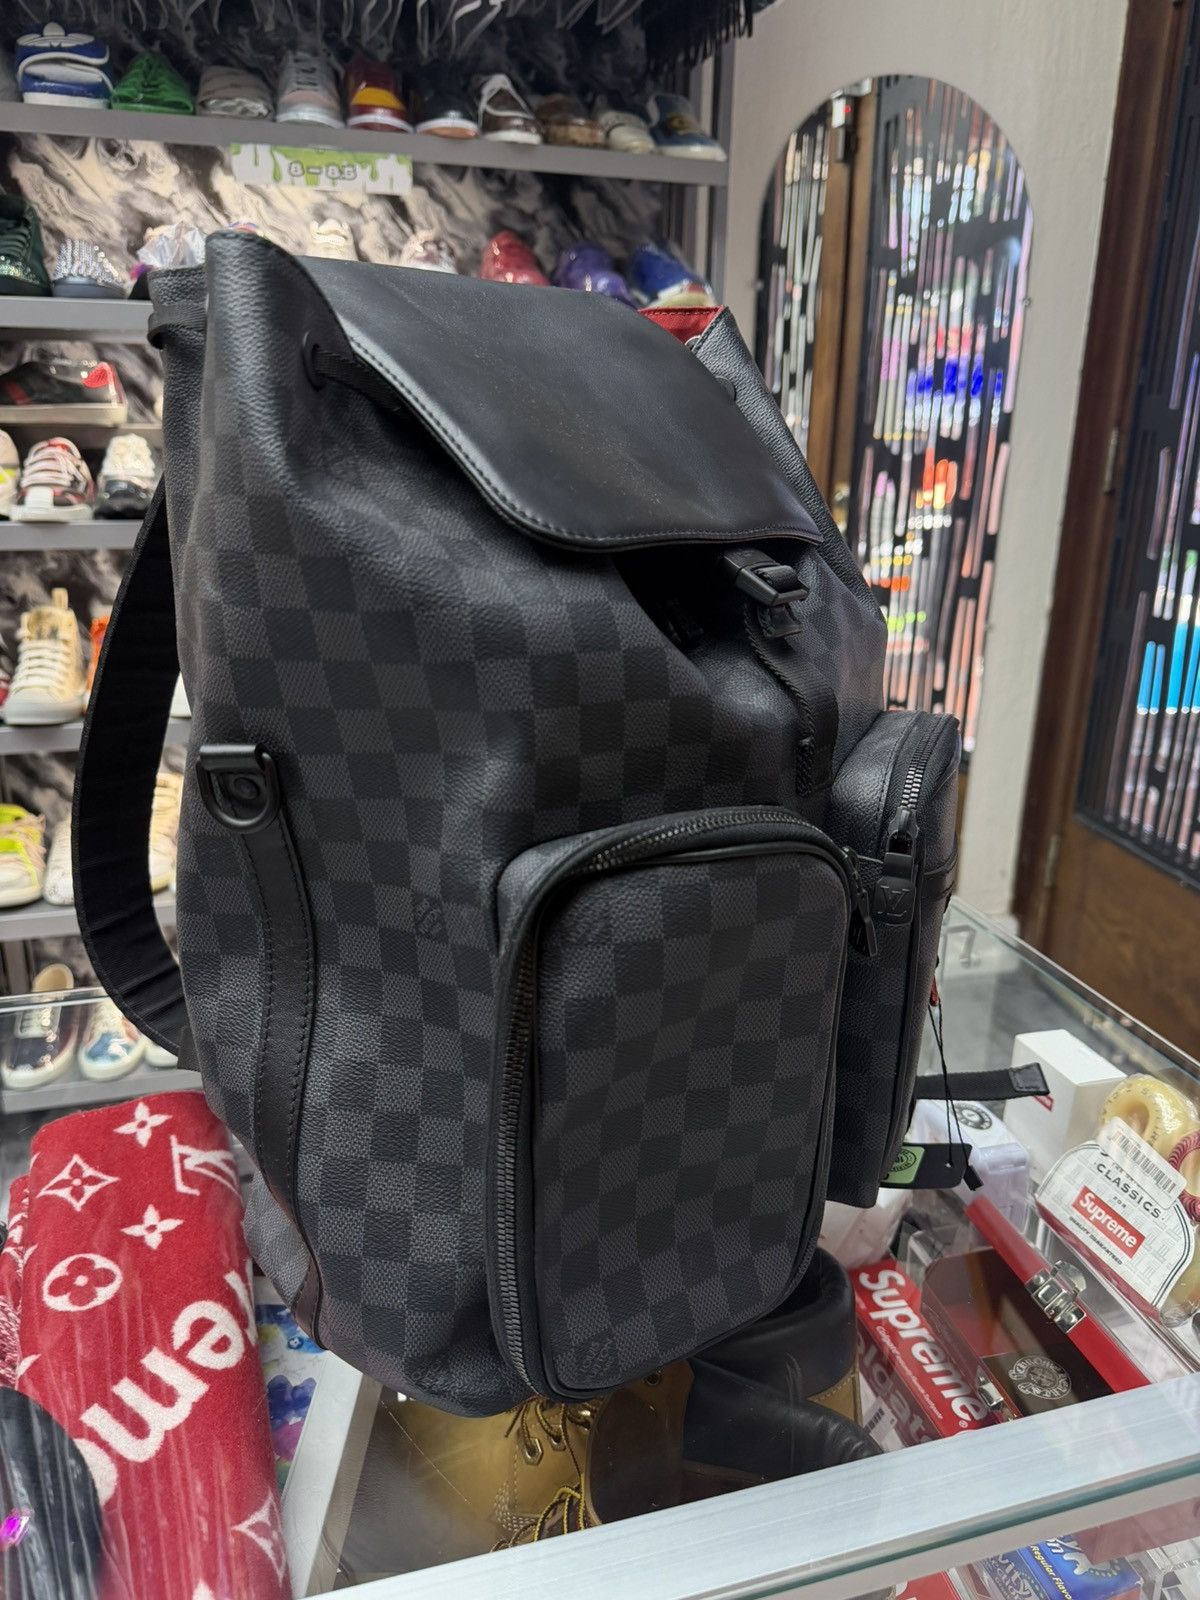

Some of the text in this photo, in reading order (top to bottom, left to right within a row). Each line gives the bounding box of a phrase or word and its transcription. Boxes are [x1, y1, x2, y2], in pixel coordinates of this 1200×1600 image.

[1095, 1162, 1162, 1219] CLASSICS
[1112, 1196, 1127, 1209] FOR
[1076, 1191, 1137, 1248] Supreme
[859, 1268, 989, 1424] Supreme
[998, 1553, 1033, 1598] vity
[1029, 1544, 1056, 1577] Regular
[1052, 1576, 1073, 1600] Flavo
